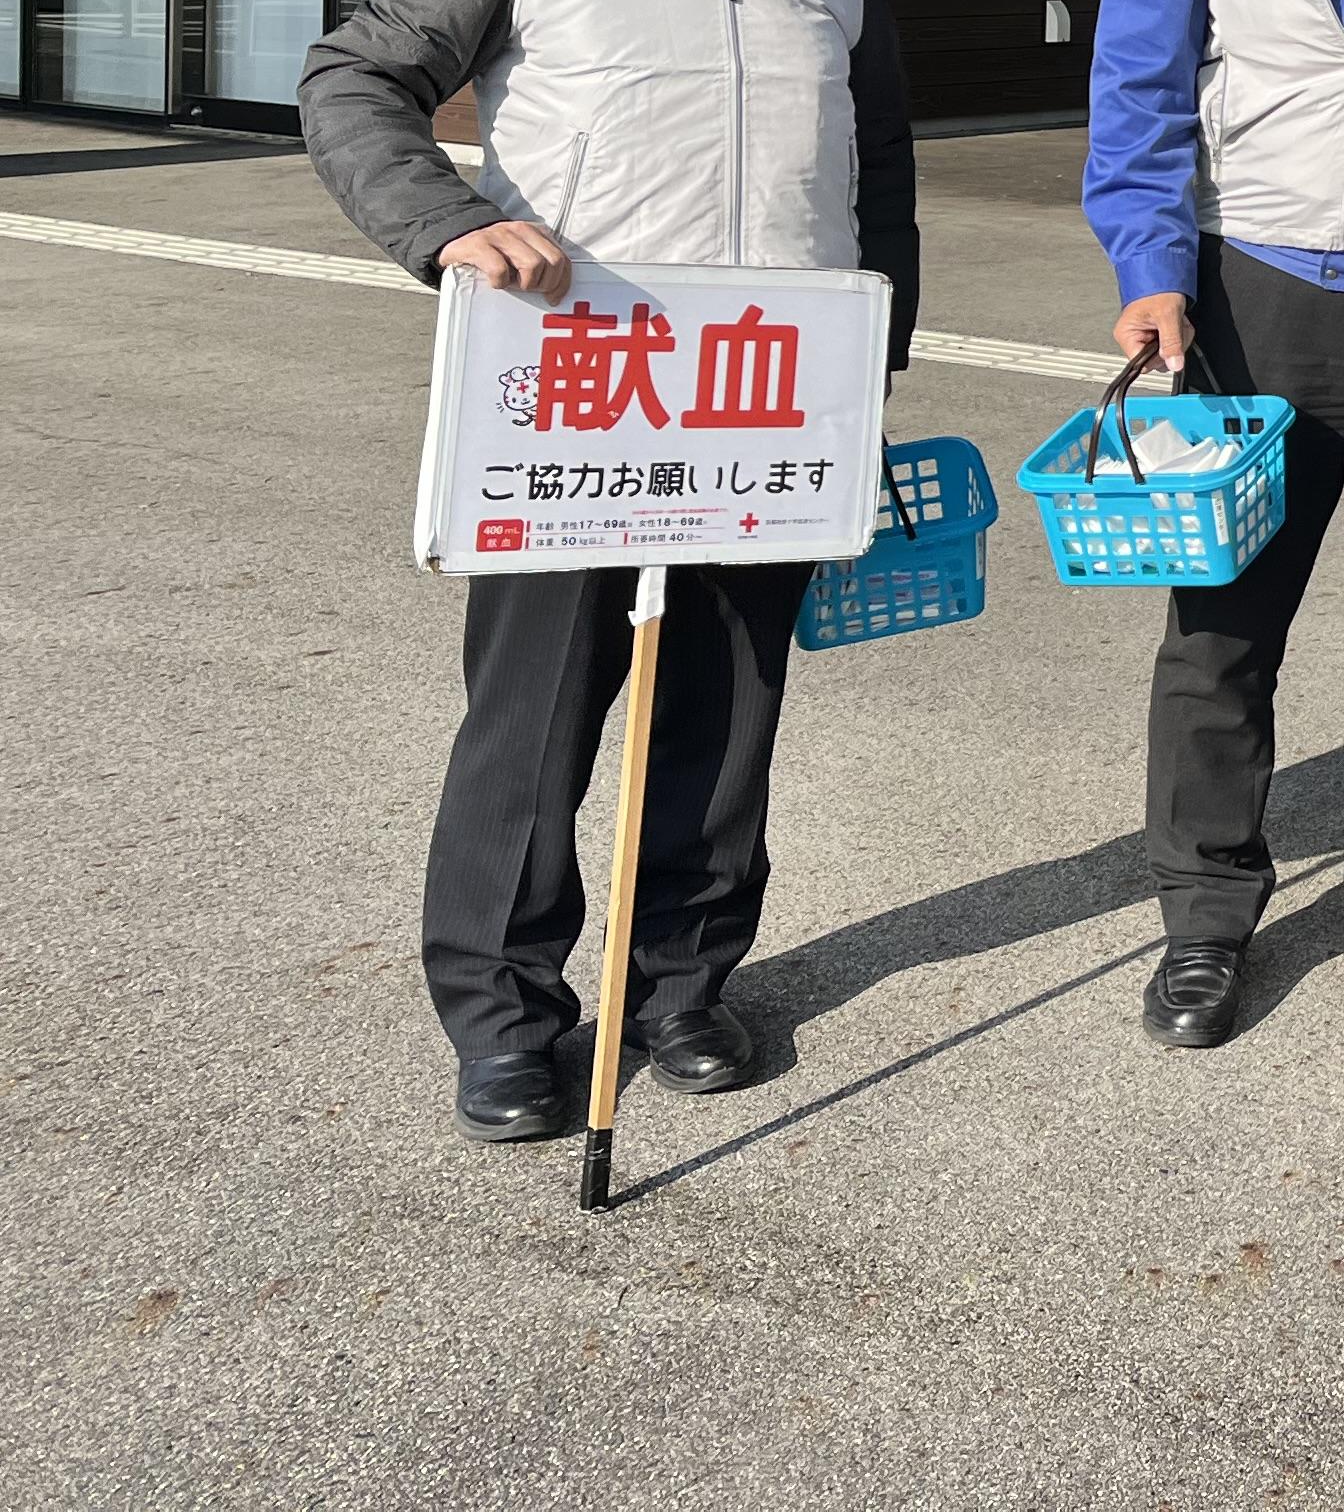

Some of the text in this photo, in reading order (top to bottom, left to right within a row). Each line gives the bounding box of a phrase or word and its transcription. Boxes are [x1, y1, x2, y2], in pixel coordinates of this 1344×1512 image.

[534, 301, 806, 432] 献血
[481, 458, 835, 501] ご協力お願いします
